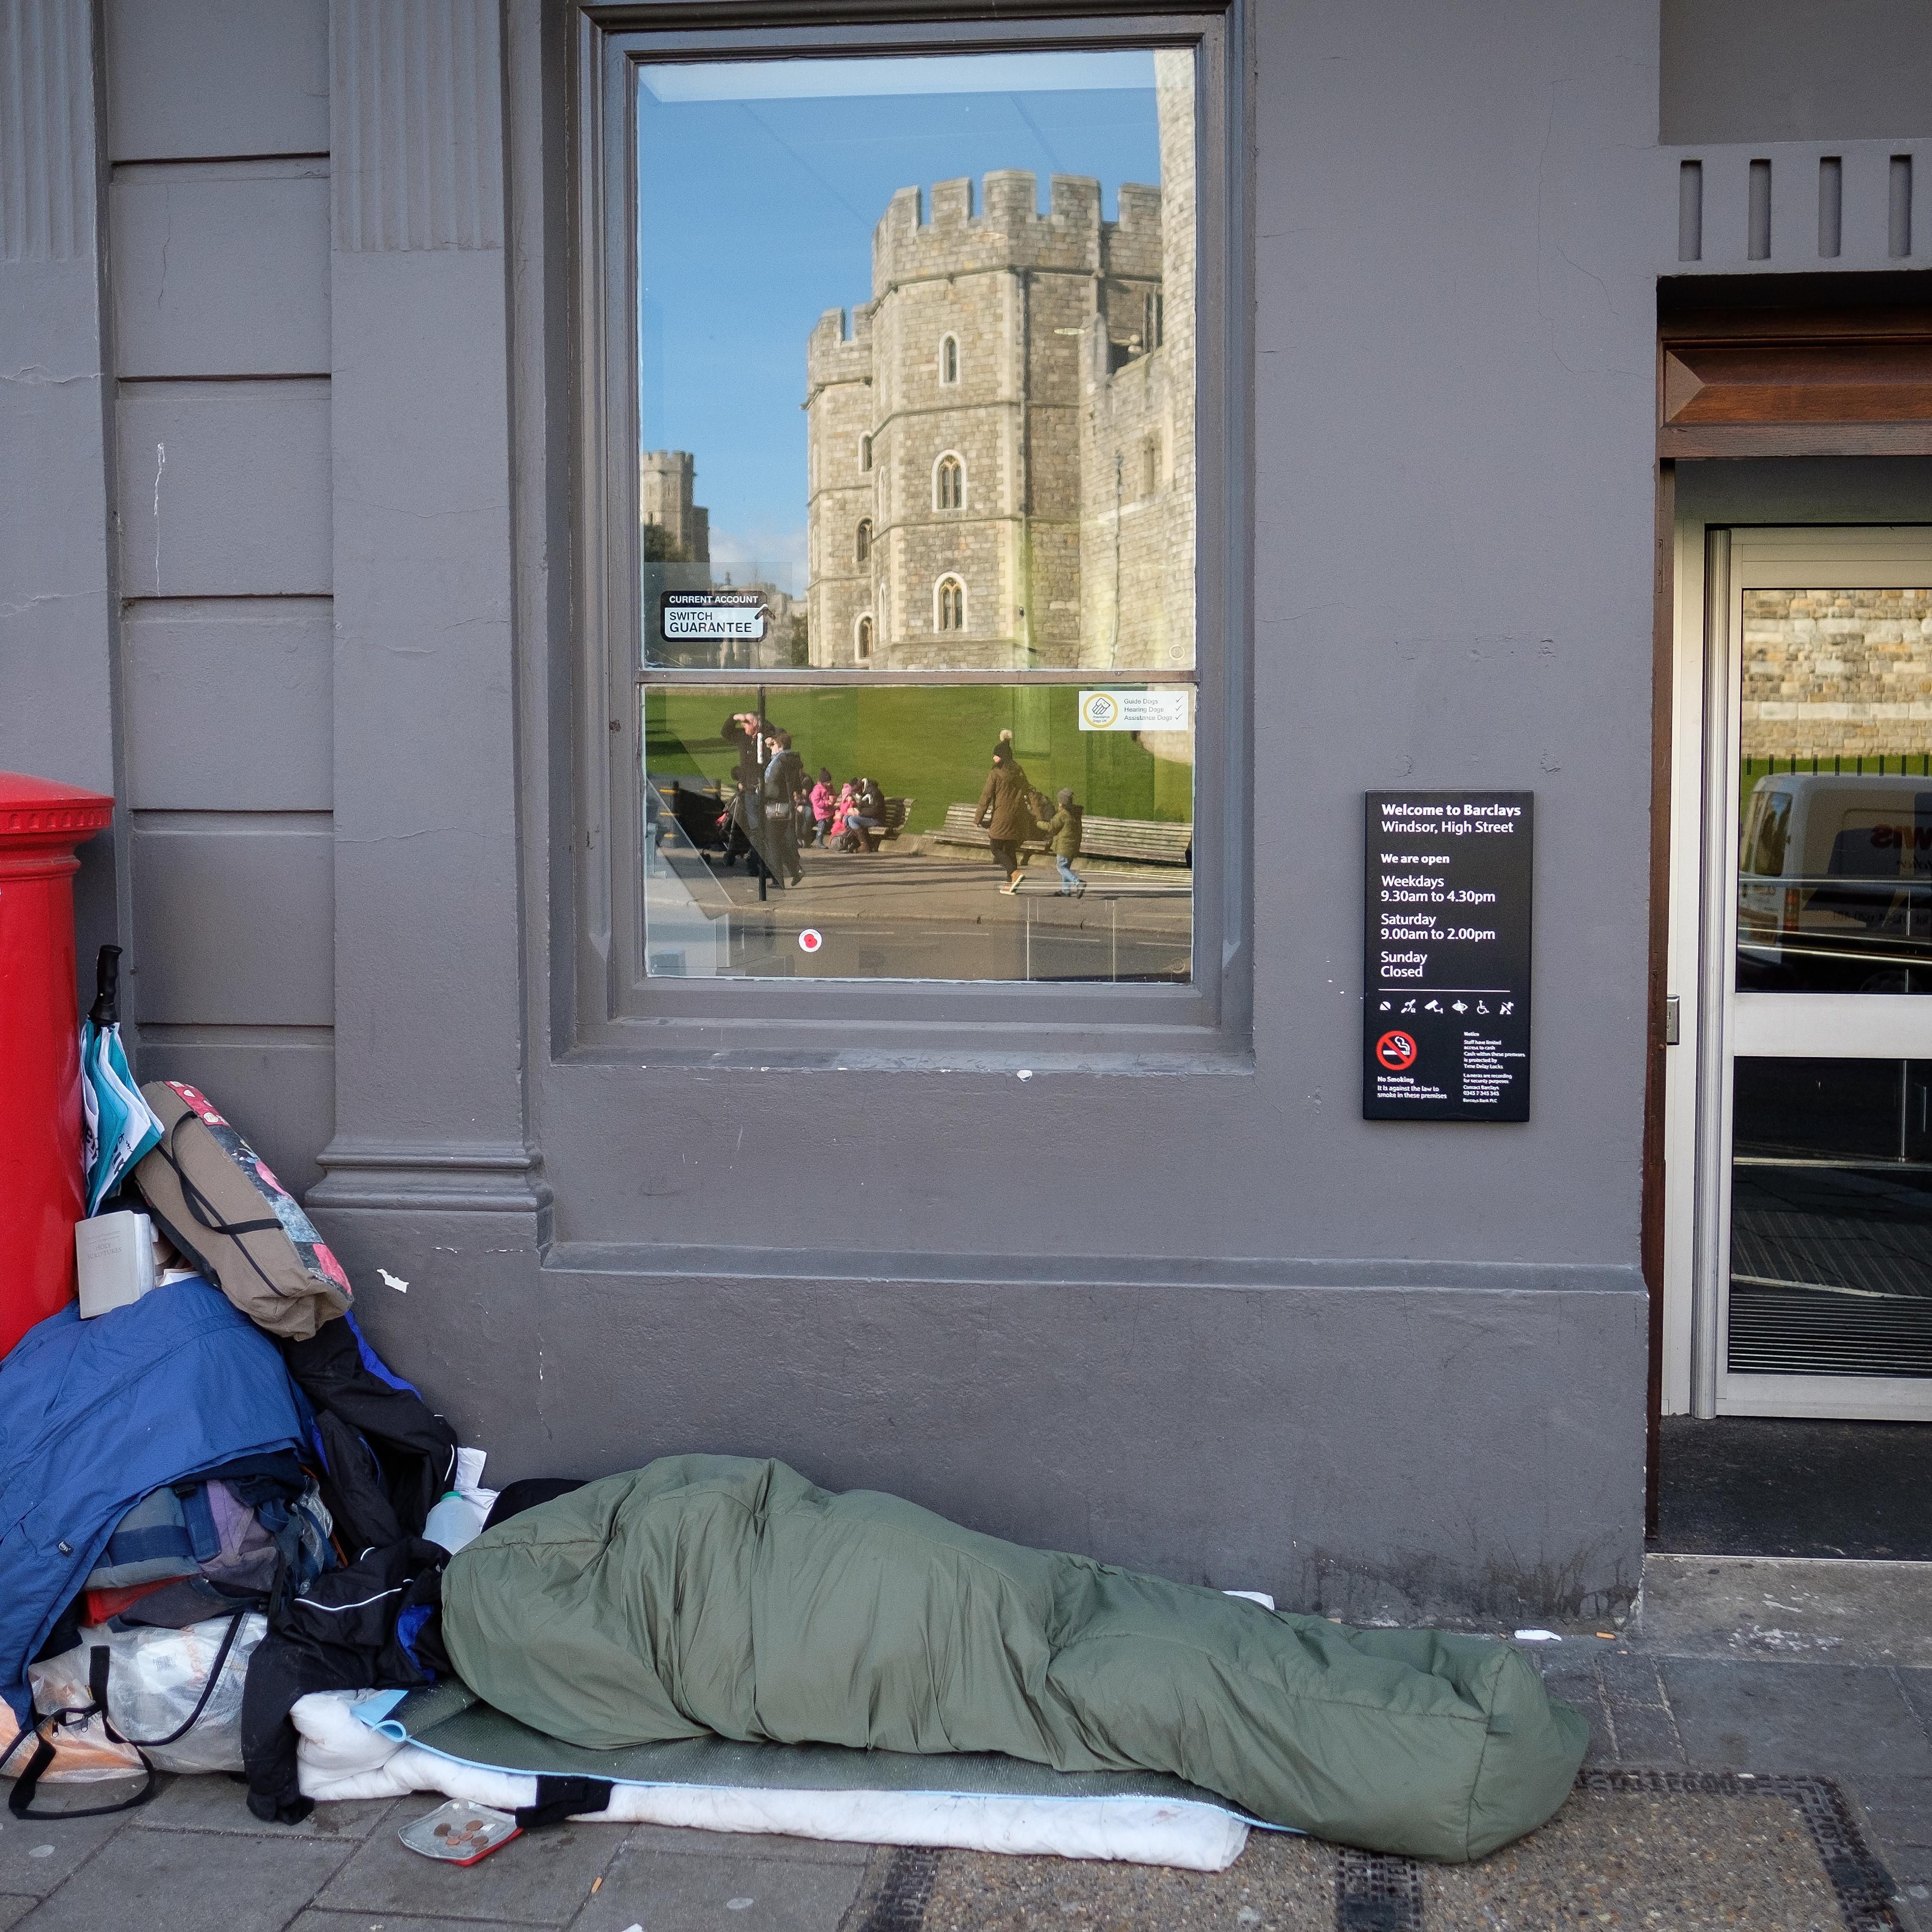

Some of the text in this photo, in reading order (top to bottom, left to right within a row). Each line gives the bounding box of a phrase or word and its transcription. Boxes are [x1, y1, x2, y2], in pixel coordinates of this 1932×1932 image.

[670, 612, 712, 620] SWITCH
[670, 622, 752, 632] GUARANTEE
[1382, 804, 1521, 817] Welcome to Barclays
[1382, 821, 1514, 836] Windsor, High Street
[1381, 853, 1398, 863] We
[1421, 856, 1450, 865] open
[1382, 875, 1444, 889] Weekdays
[1381, 891, 1495, 905] 9.30am to 4.30pm
[1381, 913, 1437, 928] Saturday
[1381, 928, 1495, 942] 9.00am to 2.00pm
[1381, 951, 1428, 965] Sunday
[1381, 965, 1423, 977] Closed
